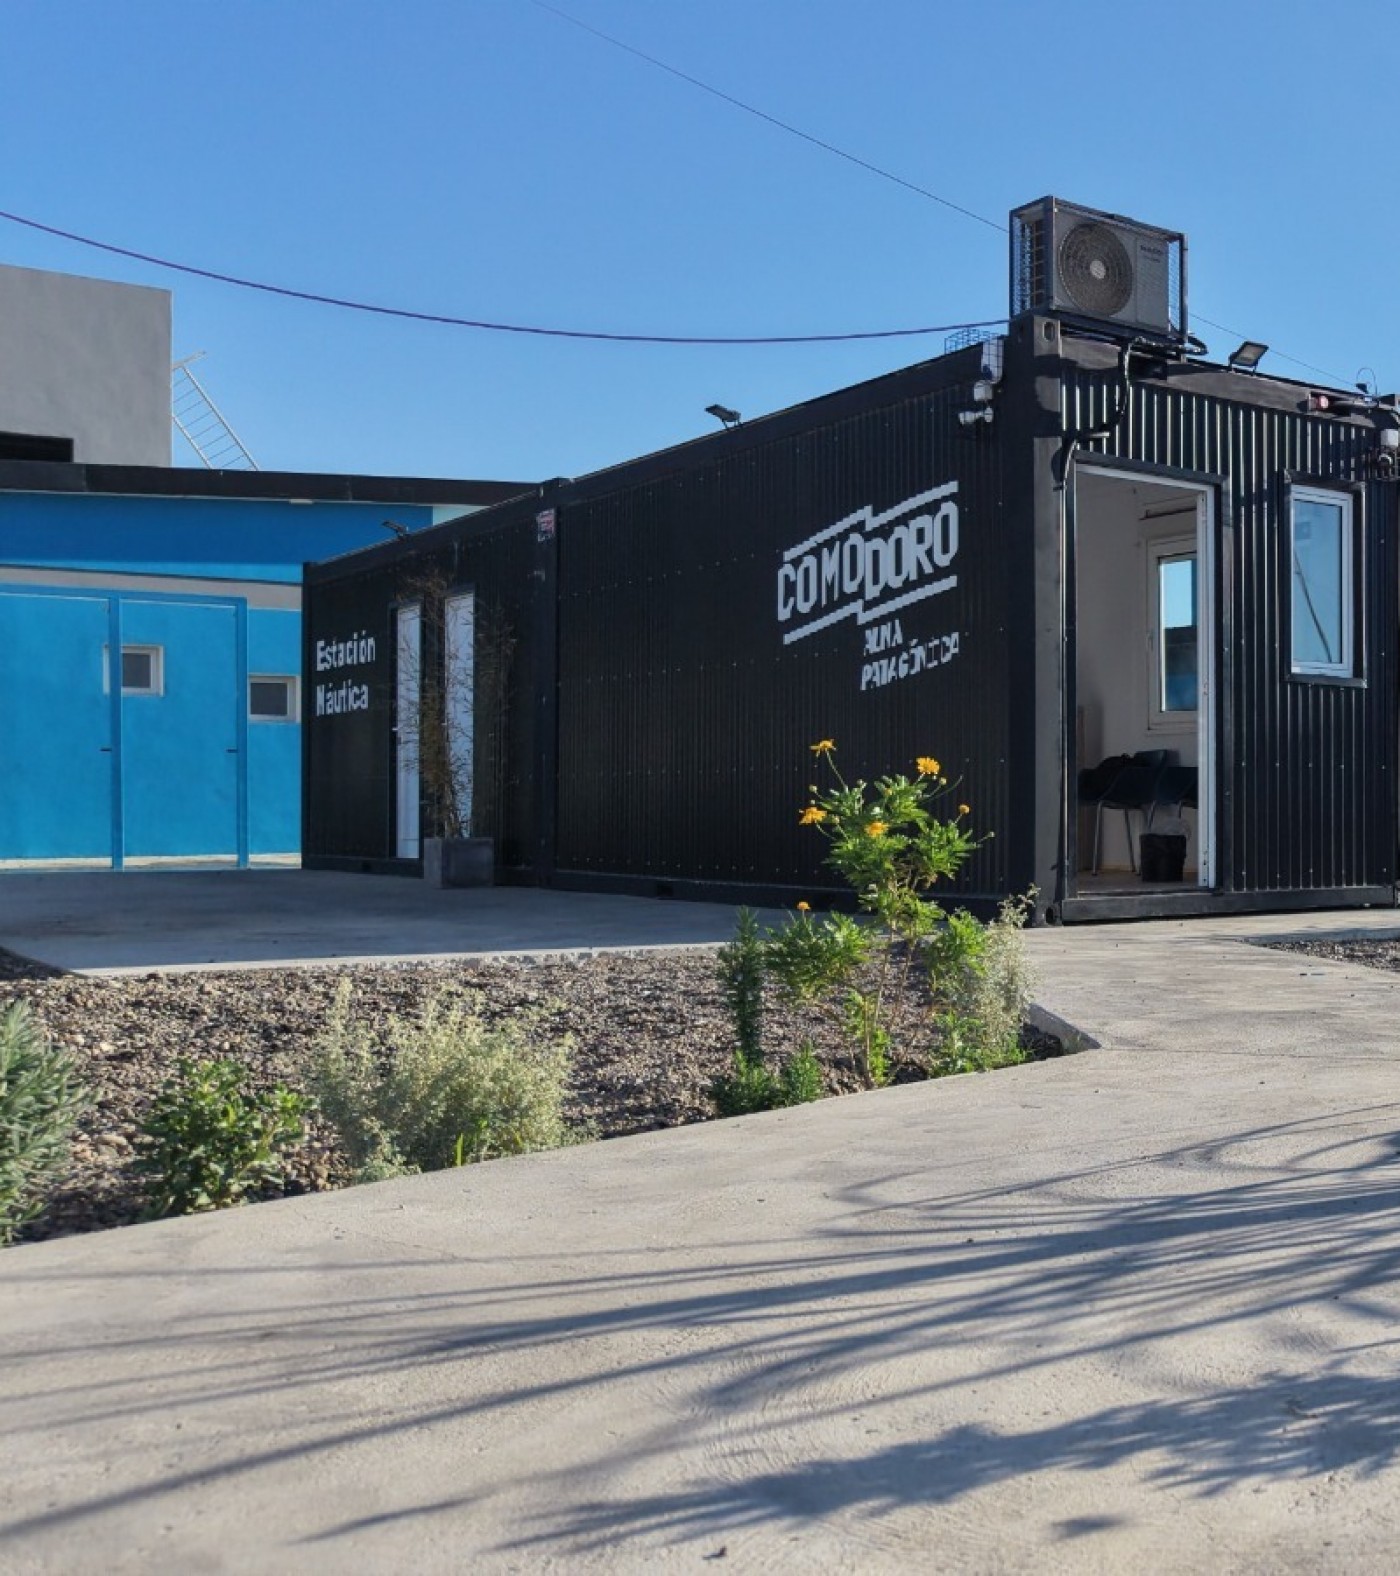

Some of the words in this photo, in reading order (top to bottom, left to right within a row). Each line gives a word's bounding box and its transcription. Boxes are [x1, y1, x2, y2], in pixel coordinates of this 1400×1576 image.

[777, 500, 959, 622] COMODORO
[316, 629, 376, 671] Estación
[316, 679, 369, 716] Náutica
